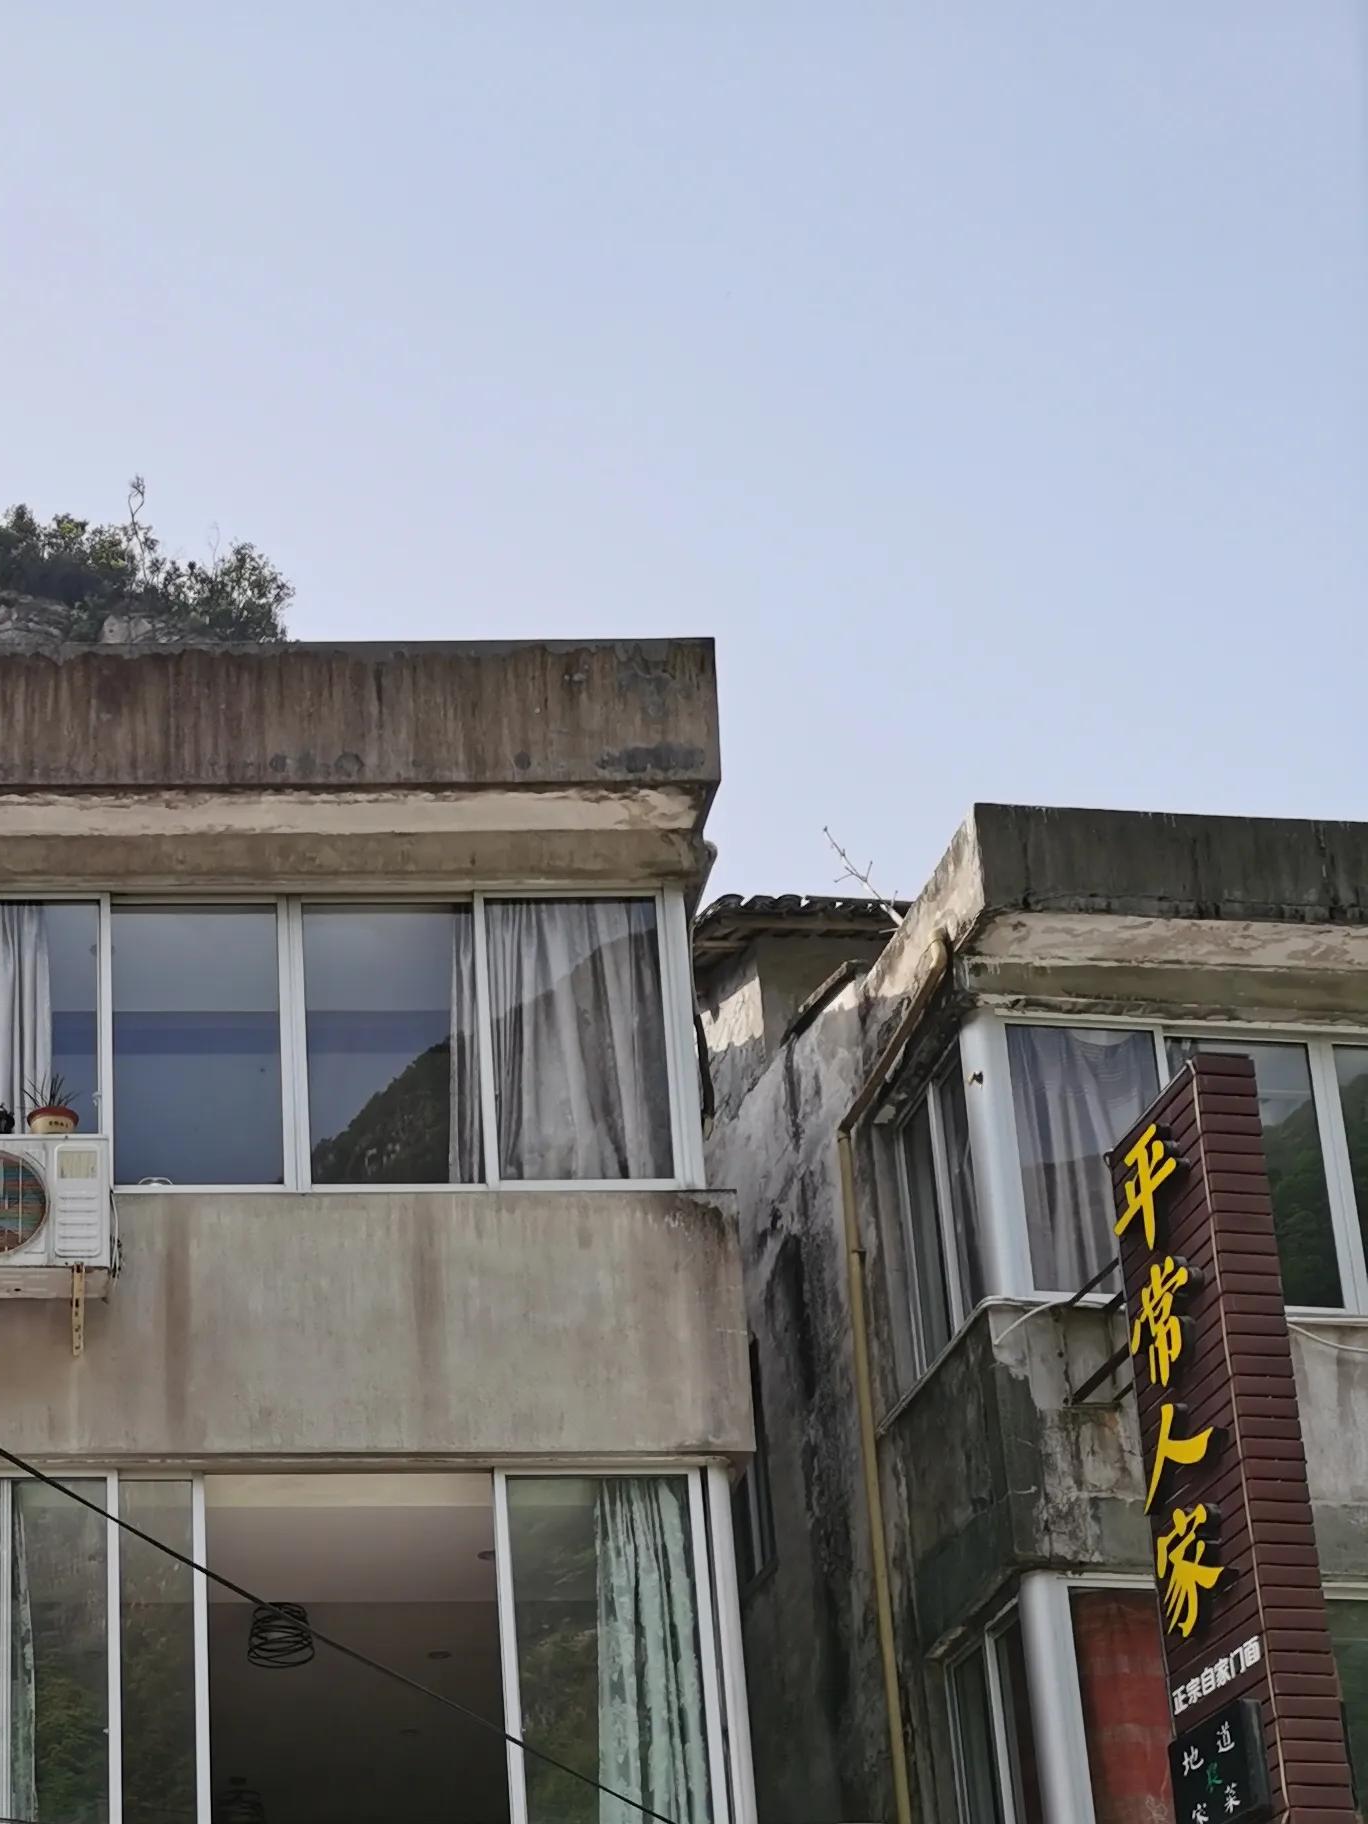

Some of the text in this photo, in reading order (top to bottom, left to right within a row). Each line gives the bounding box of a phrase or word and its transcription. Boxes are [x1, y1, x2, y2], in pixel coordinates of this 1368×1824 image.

[1115, 1124, 1224, 1638] 平常人家
[1172, 1635, 1262, 1715] 正宗自家门面
